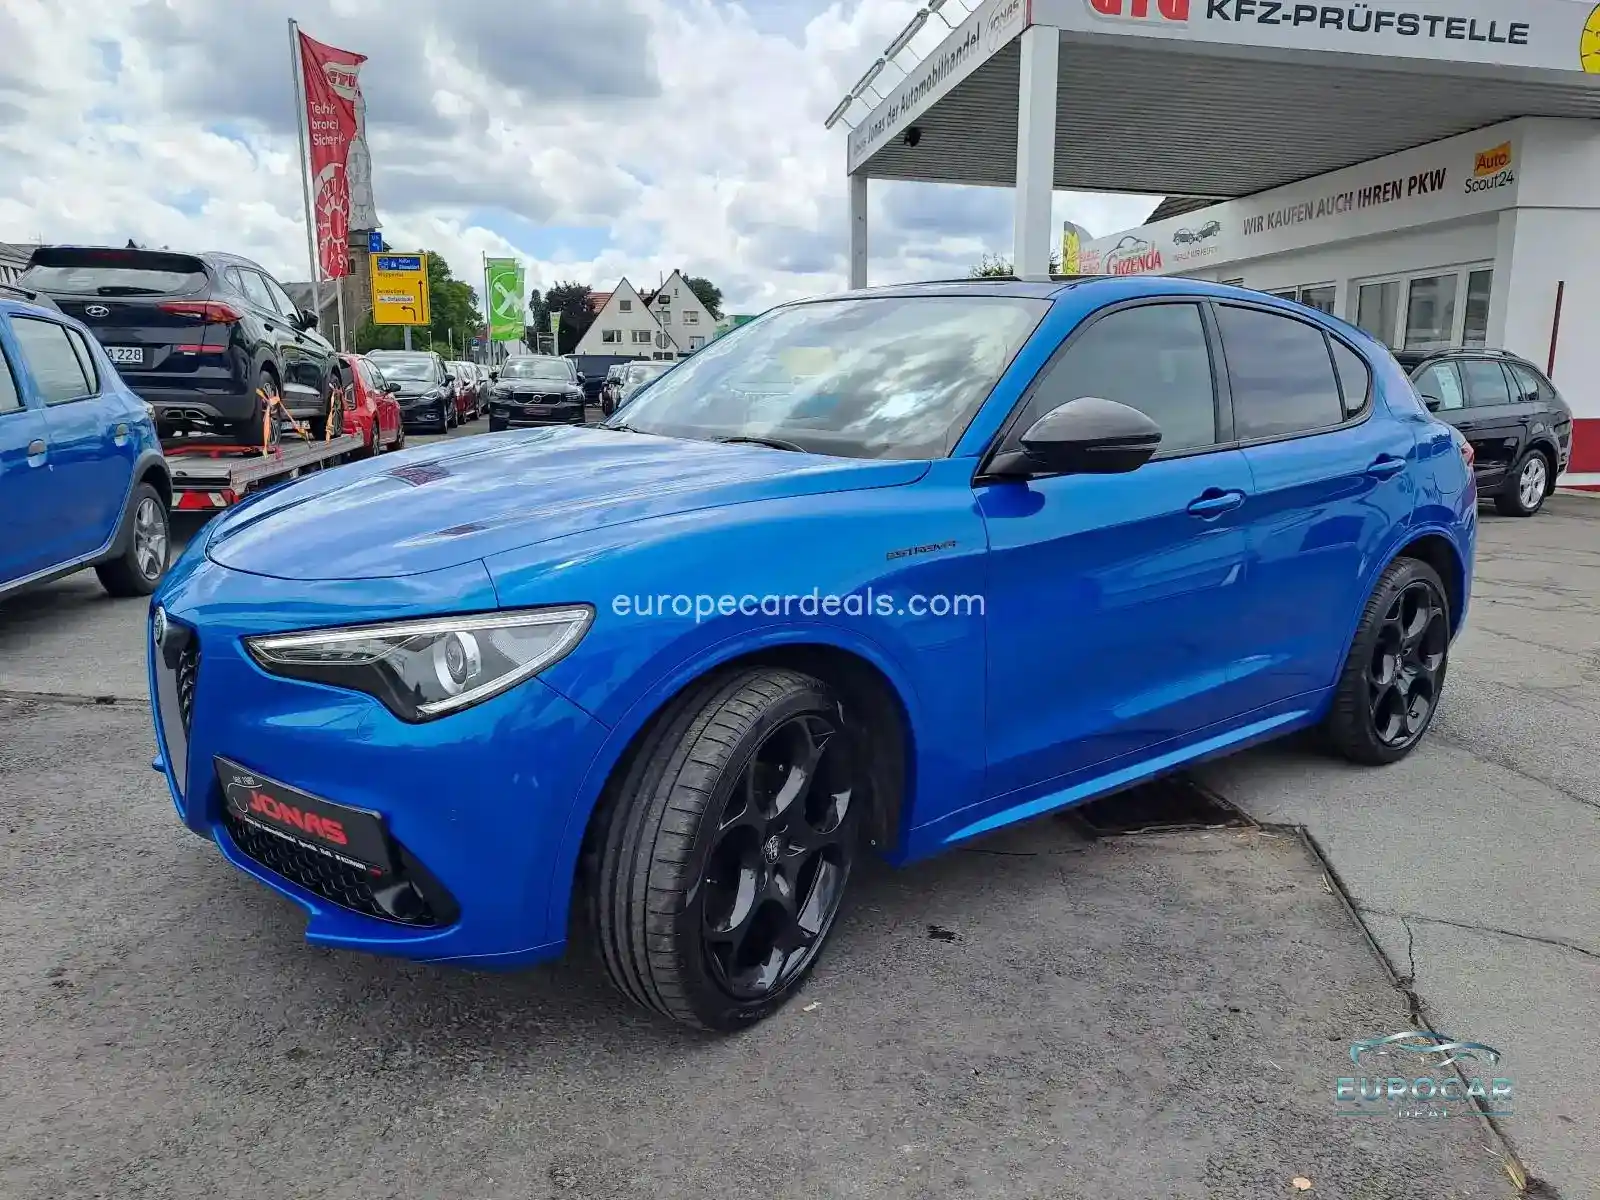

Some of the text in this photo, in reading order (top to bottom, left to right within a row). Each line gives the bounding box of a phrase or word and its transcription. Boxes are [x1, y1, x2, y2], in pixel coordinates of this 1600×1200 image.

[1206, 0, 1530, 45] KFZ-PRÜFSTELLE
[867, 21, 980, 144] Jonas der Automobilhandel
[1464, 168, 1515, 194] Scout24
[1475, 152, 1508, 171] Auto
[1243, 167, 1447, 236] WIR KAUFEN AUCH IHREN PKW
[117, 348, 141, 360] 228
[249, 790, 349, 846] JONAS
